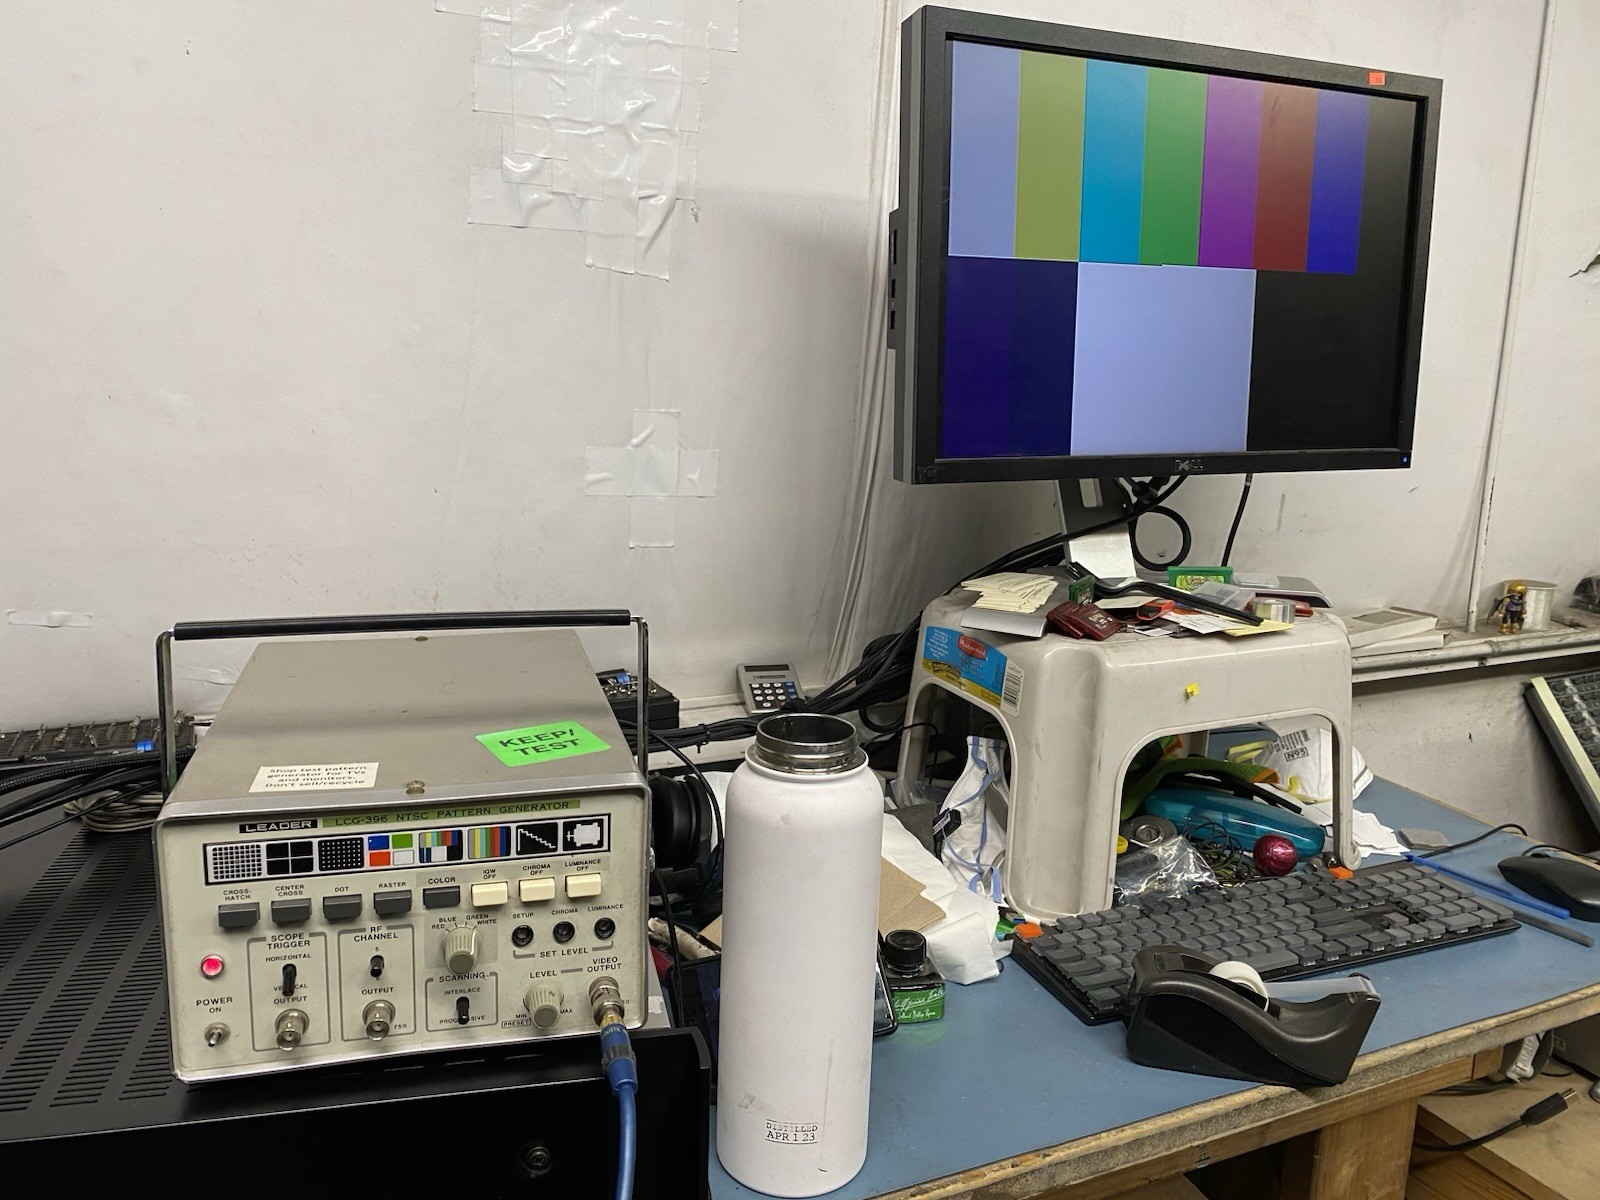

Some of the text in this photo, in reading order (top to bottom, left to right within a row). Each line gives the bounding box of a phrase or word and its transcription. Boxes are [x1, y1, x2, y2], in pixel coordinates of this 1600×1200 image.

[513, 738, 579, 756] TEST
[1287, 748, 1306, 760] N95
[335, 801, 570, 826] LCG-396 NTSC PATTERN GENERATOR
[245, 820, 312, 833] LEADER
[522, 863, 551, 872] CHROMA
[564, 858, 602, 868] LUMINANCE
[378, 881, 407, 889] RASTER
[428, 877, 456, 885] COLOR
[223, 888, 252, 896] CROSS-
[275, 884, 305, 892] CENTER
[551, 908, 579, 916] CHROMA
[587, 904, 624, 912] LUMINANCE
[512, 912, 534, 920] SETUP
[477, 918, 498, 926] WHITE
[271, 932, 305, 942] SCOPE
[353, 932, 399, 942] CHANNEL
[267, 940, 311, 950] TRIGGER
[540, 947, 589, 958] SET LEVEL
[265, 953, 312, 962] HORIZONTAL
[592, 956, 618, 965] VIDEO
[587, 963, 622, 973] OUTPUT
[439, 972, 486, 983] SCANNING
[530, 970, 558, 979] LEVEL
[273, 984, 308, 992] VECAL
[361, 987, 395, 996] OUTPUT
[444, 986, 481, 996] INTERLACE
[196, 997, 233, 1007] POWER
[273, 995, 308, 1005] OUTPUT
[439, 1015, 486, 1024] PROGSIVE
[503, 1019, 529, 1027] PRESET
[766, 1130, 816, 1142] APR 1 23
